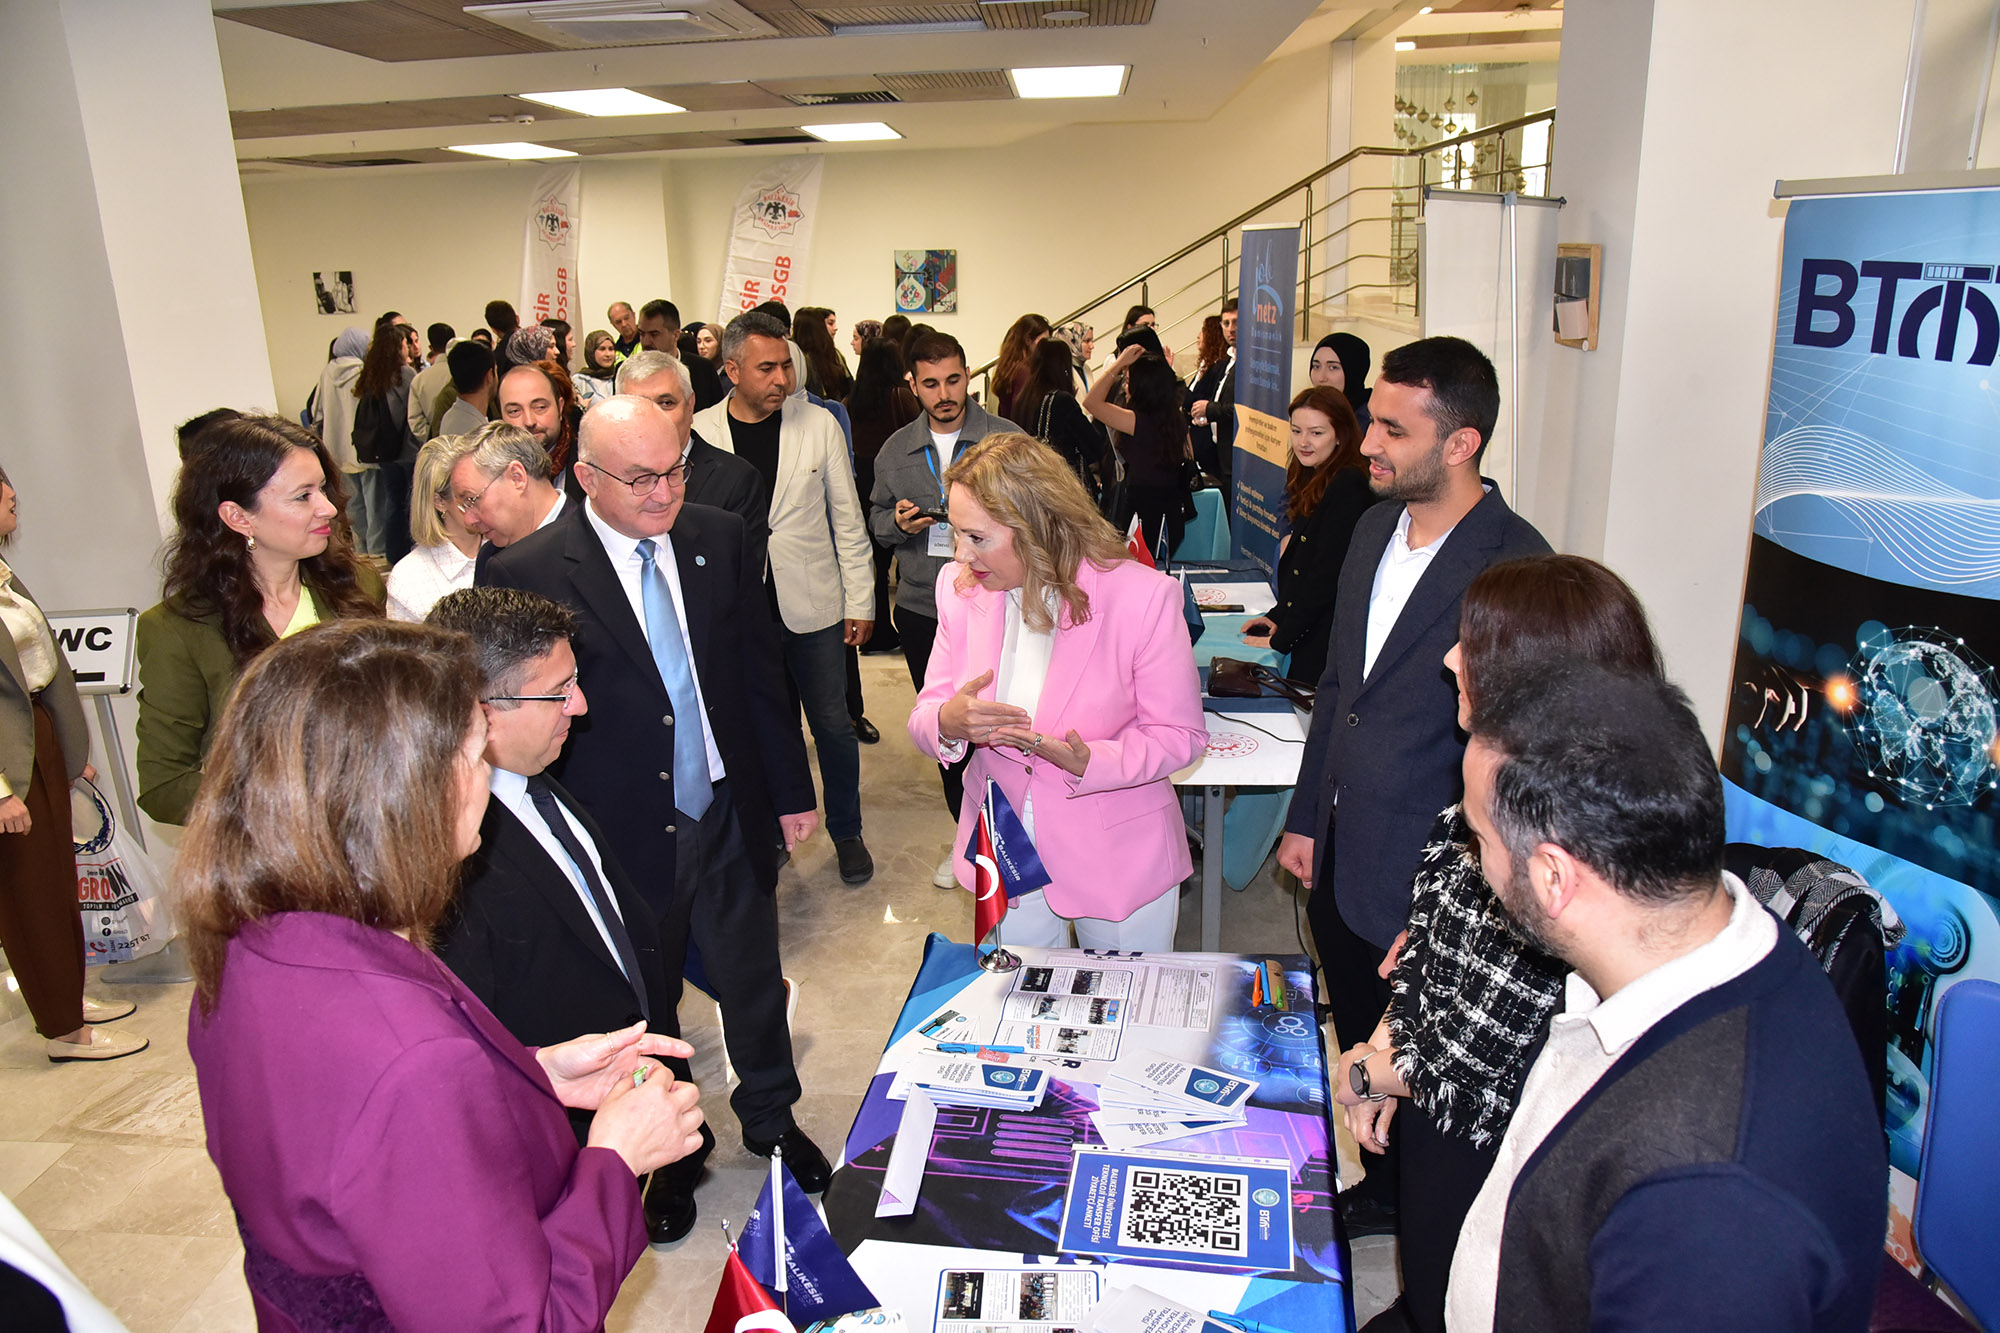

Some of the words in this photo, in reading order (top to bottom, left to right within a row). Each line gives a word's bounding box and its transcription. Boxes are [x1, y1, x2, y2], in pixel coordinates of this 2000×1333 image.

[740, 280, 761, 314] SİR
[1257, 301, 1277, 324] netz
[52, 627, 113, 652] WC
[1086, 1176, 1099, 1205] ZİYARETÇİ
[1099, 1164, 1110, 1195] TEKNOLOJİ
[1108, 1168, 1119, 1197] BALIKESİR
[1083, 1205, 1093, 1228] ANKETİ
[1094, 1196, 1105, 1225] TRANSFER
[1102, 1198, 1116, 1239] ÜNİVERSİTESİ
[1091, 1226, 1100, 1243] OFİSİ
[785, 1253, 824, 1304] BALIKESİR
